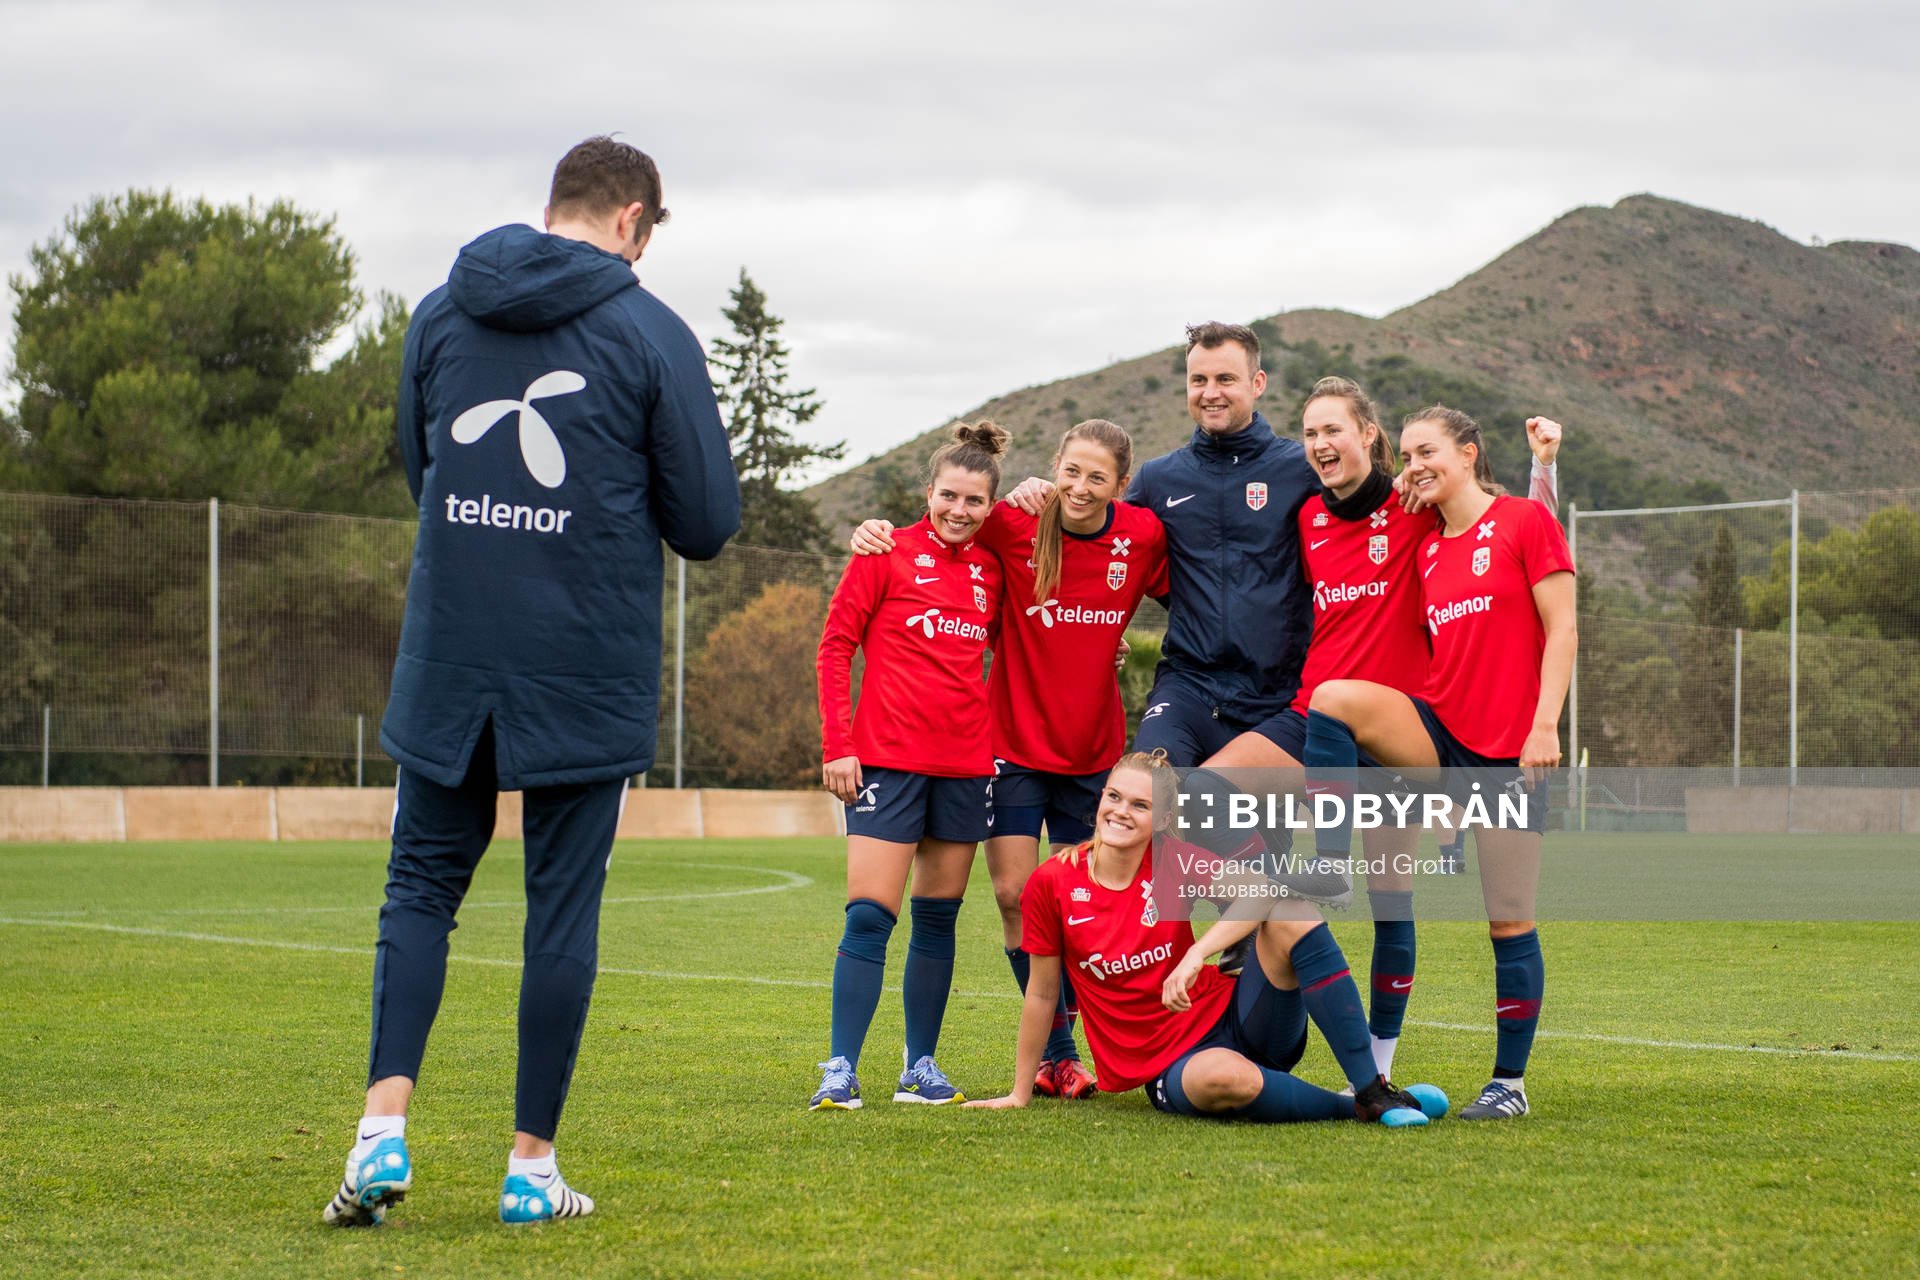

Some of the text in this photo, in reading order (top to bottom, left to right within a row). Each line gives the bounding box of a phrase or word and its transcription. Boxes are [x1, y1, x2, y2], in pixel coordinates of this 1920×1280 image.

[445, 493, 572, 534] telenor
[1324, 581, 1389, 604] telenor
[1056, 604, 1126, 625] telenor
[1434, 595, 1494, 626] telenor
[936, 615, 988, 642] teleno
[1101, 941, 1173, 975] telenor
